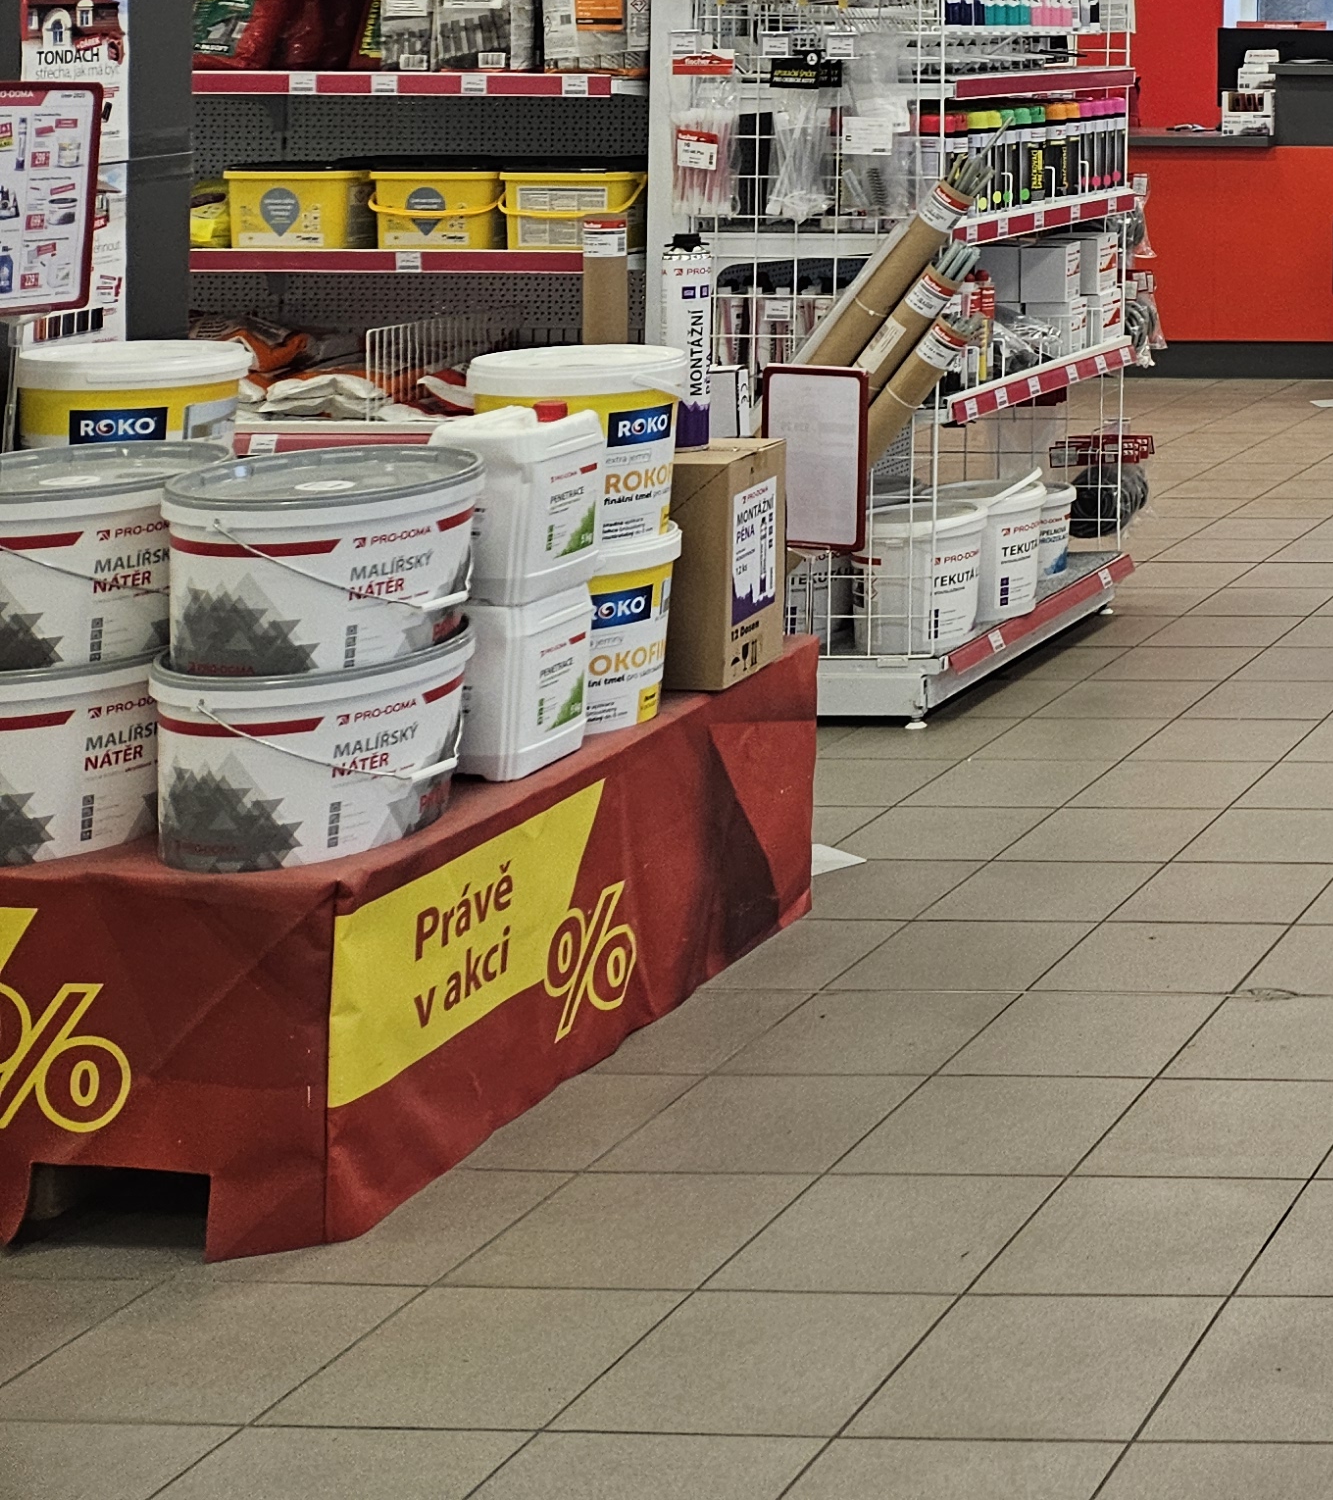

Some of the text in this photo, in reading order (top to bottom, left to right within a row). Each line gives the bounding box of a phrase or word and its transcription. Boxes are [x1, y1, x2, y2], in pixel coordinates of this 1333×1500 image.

[36, 48, 100, 66] TONDACH
[684, 57, 711, 66] fischer
[687, 309, 704, 396] MONTÁŽNÍ
[80, 417, 156, 437] ROKO
[617, 413, 669, 438] ROKO
[635, 491, 653, 503] tmel
[736, 493, 775, 527] MONTÁŽNÍ
[114, 521, 171, 539] PRO-DOM
[370, 525, 432, 547] PRO-DOMA
[736, 523, 756, 545] PĚNA
[94, 547, 171, 575] MALÍŘSK
[350, 548, 433, 582] MALÍŘSKÝ
[92, 570, 152, 595] NÁTĚR
[348, 577, 405, 602] NÁTĚR
[354, 698, 417, 723] PRO-DOMA
[86, 721, 158, 752] MALÍŘS
[333, 720, 419, 759] MALÍŘSKÝ
[84, 744, 144, 772] NÁTĚR
[331, 752, 390, 779] NÁTĚR
[415, 861, 513, 962] Právě
[544, 879, 637, 1044] %
[413, 925, 512, 1029] v akci
